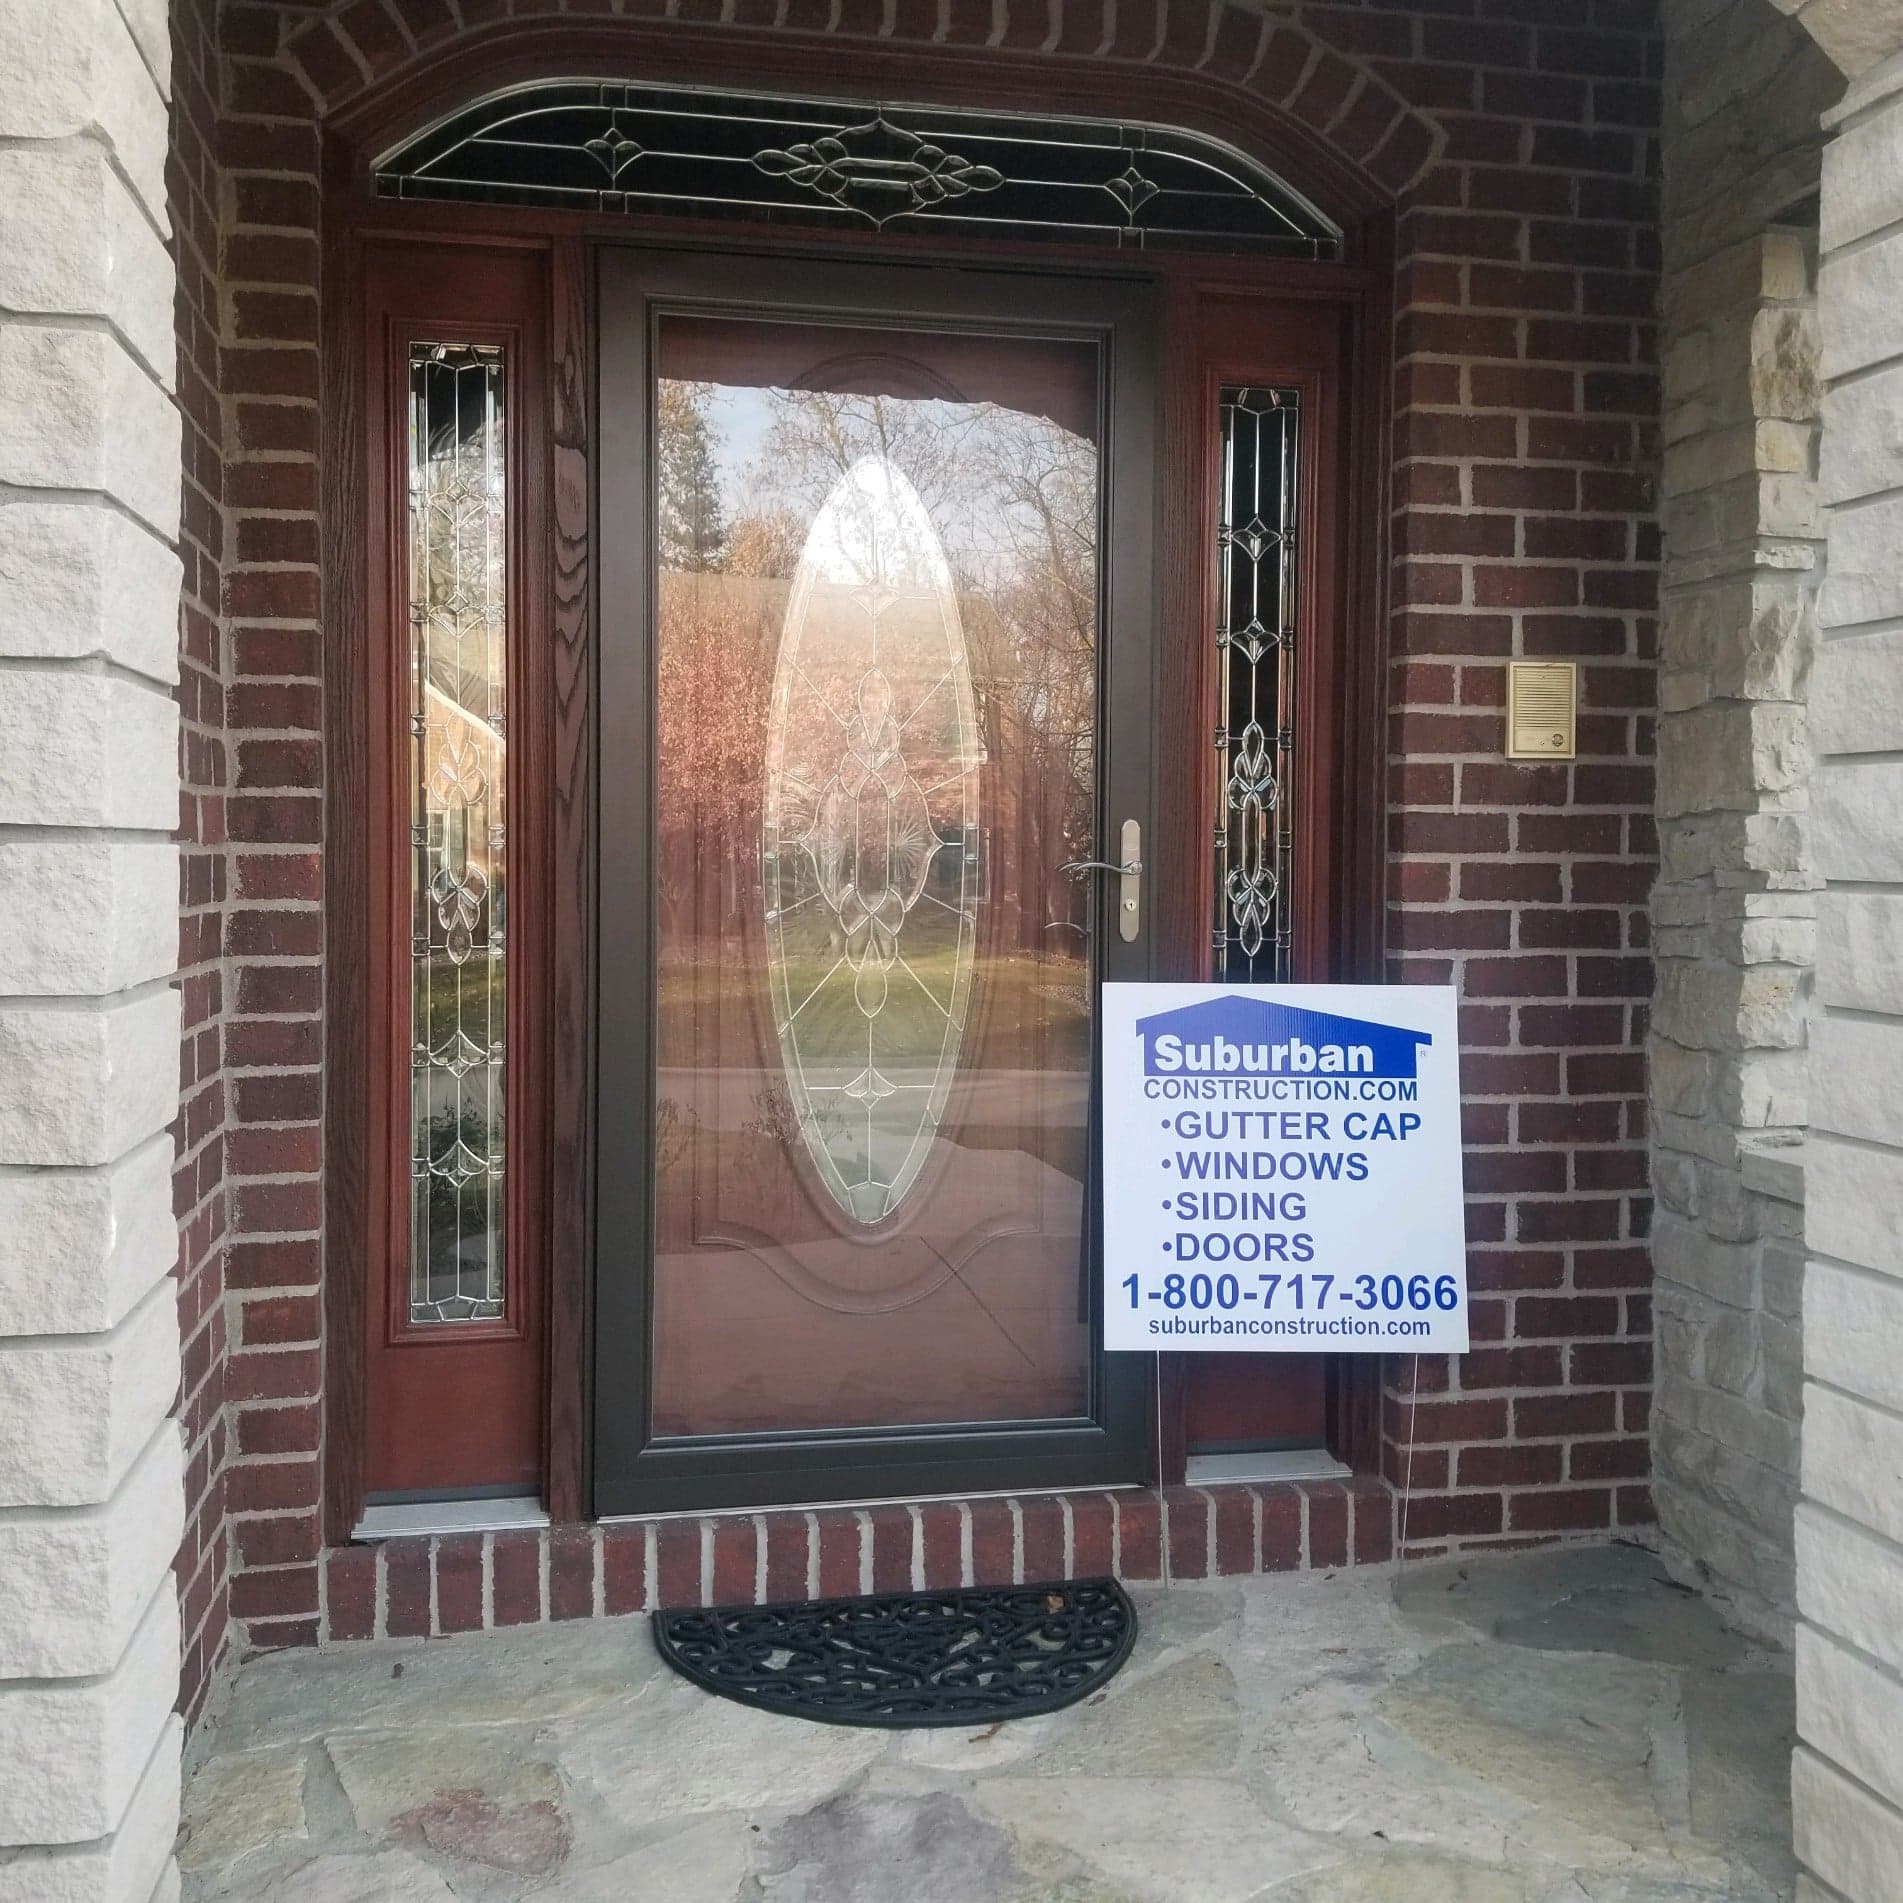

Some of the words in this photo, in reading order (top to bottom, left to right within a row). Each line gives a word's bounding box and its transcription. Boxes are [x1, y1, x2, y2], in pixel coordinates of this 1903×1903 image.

[1153, 1034, 1374, 1073] Suburban
[1143, 1078, 1418, 1101] CONSTRUCTION.COM
[1174, 1111, 1331, 1140] GUTTER
[1343, 1111, 1422, 1141] CAP
[1176, 1151, 1369, 1181] WINDOWS
[1175, 1191, 1307, 1221] SIDING
[1176, 1232, 1315, 1262] DOORS
[1122, 1272, 1458, 1311] 1-800-717-3066
[1148, 1315, 1431, 1336] suburbanconstruction.com
